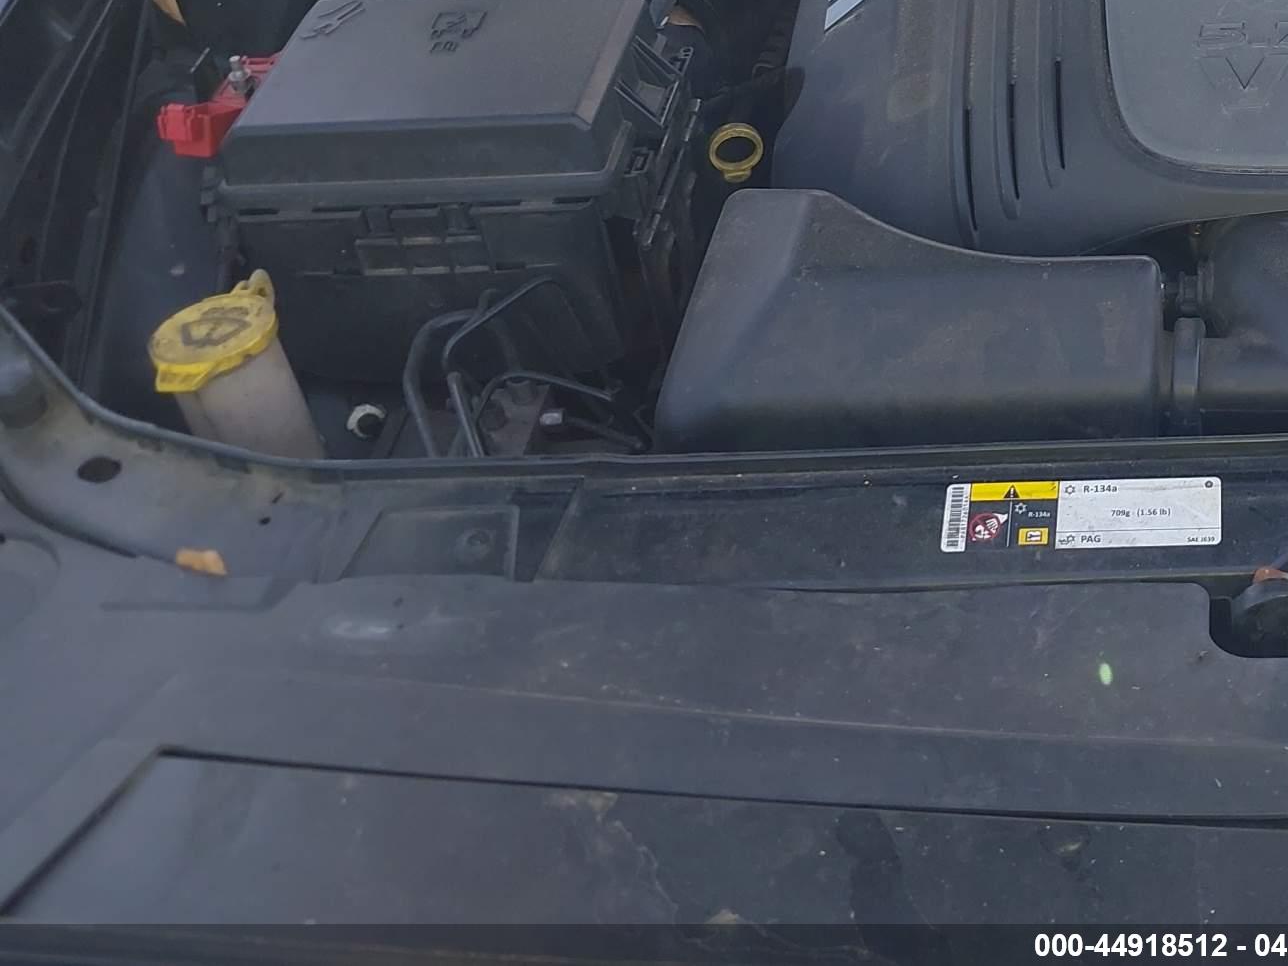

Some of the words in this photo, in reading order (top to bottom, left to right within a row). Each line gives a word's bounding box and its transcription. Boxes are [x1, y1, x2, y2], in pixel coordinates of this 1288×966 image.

[1083, 484, 1118, 494] R-134a
[1111, 509, 1130, 517] 709g
[1137, 508, 1158, 516] (1.56
[1159, 508, 1171, 516] lb)
[1081, 535, 1101, 543] PAG
